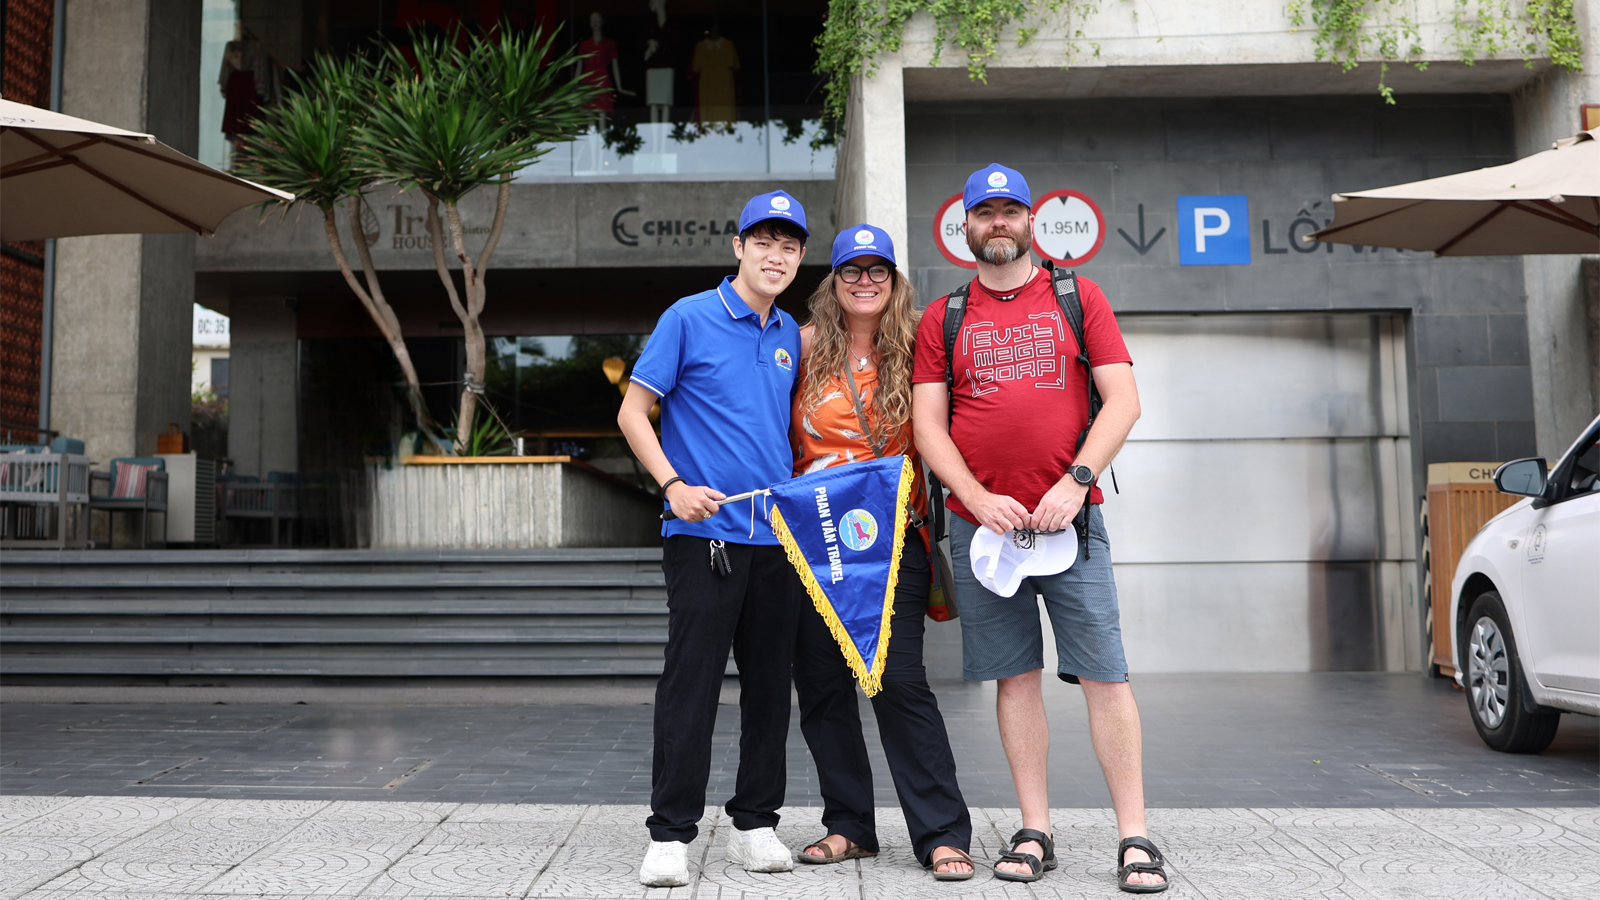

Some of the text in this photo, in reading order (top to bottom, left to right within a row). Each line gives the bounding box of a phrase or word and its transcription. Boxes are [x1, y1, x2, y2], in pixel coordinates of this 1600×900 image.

[642, 219, 740, 236] CHIC-LA
[945, 223, 966, 237] 5K
[1041, 221, 1089, 235] 1.95M
[1194, 207, 1231, 253] P
[657, 237, 726, 246] FASHI
[973, 323, 1054, 348] EVIL
[975, 359, 1056, 386] CORP
[814, 486, 844, 585] PHAN VĂN TRAVEL
